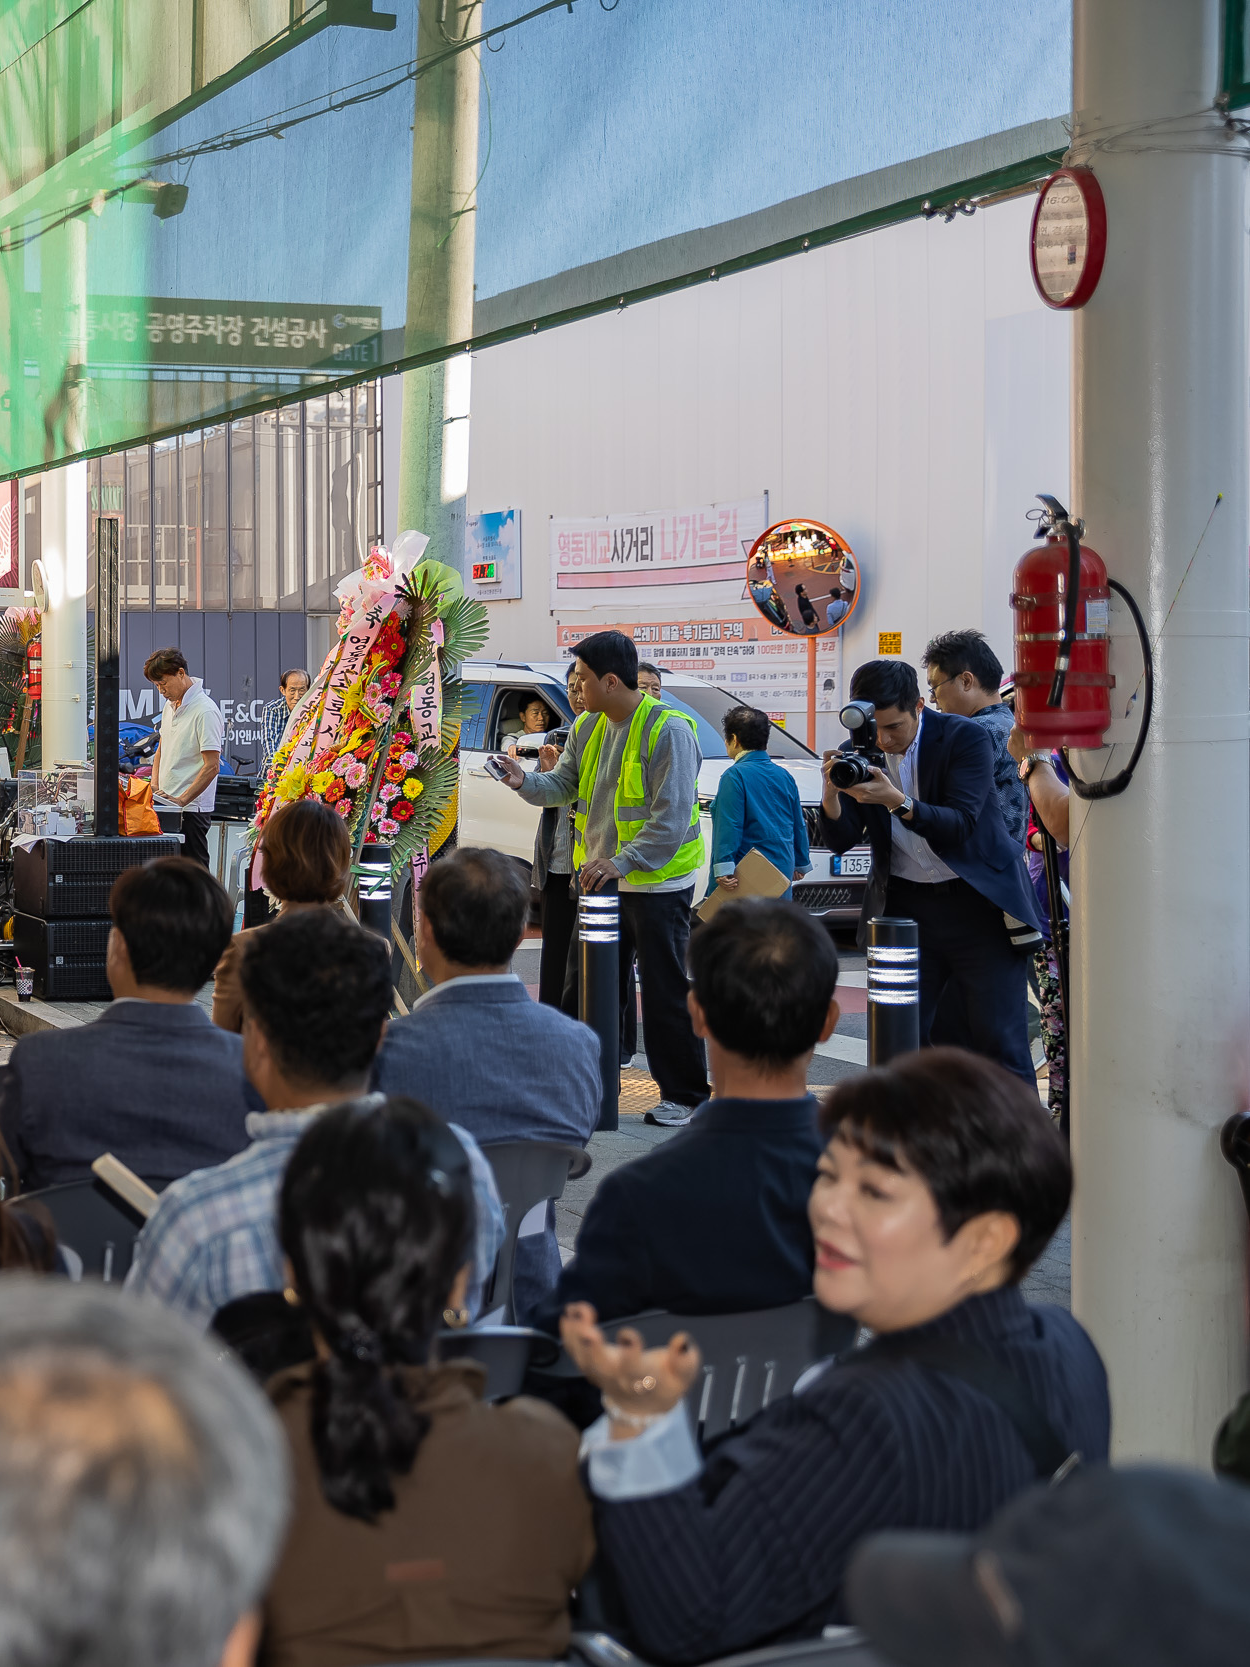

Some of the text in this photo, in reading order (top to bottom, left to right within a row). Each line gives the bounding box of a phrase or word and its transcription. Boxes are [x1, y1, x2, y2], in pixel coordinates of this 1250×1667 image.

[145, 312, 245, 346] 공영주차장
[251, 317, 328, 348] 건설공사
[333, 338, 379, 362] GATE 1
[661, 508, 737, 561] 나가는길
[365, 605, 383, 630] 축
[633, 622, 743, 643] 쓰레기 배출·투기금지 구역
